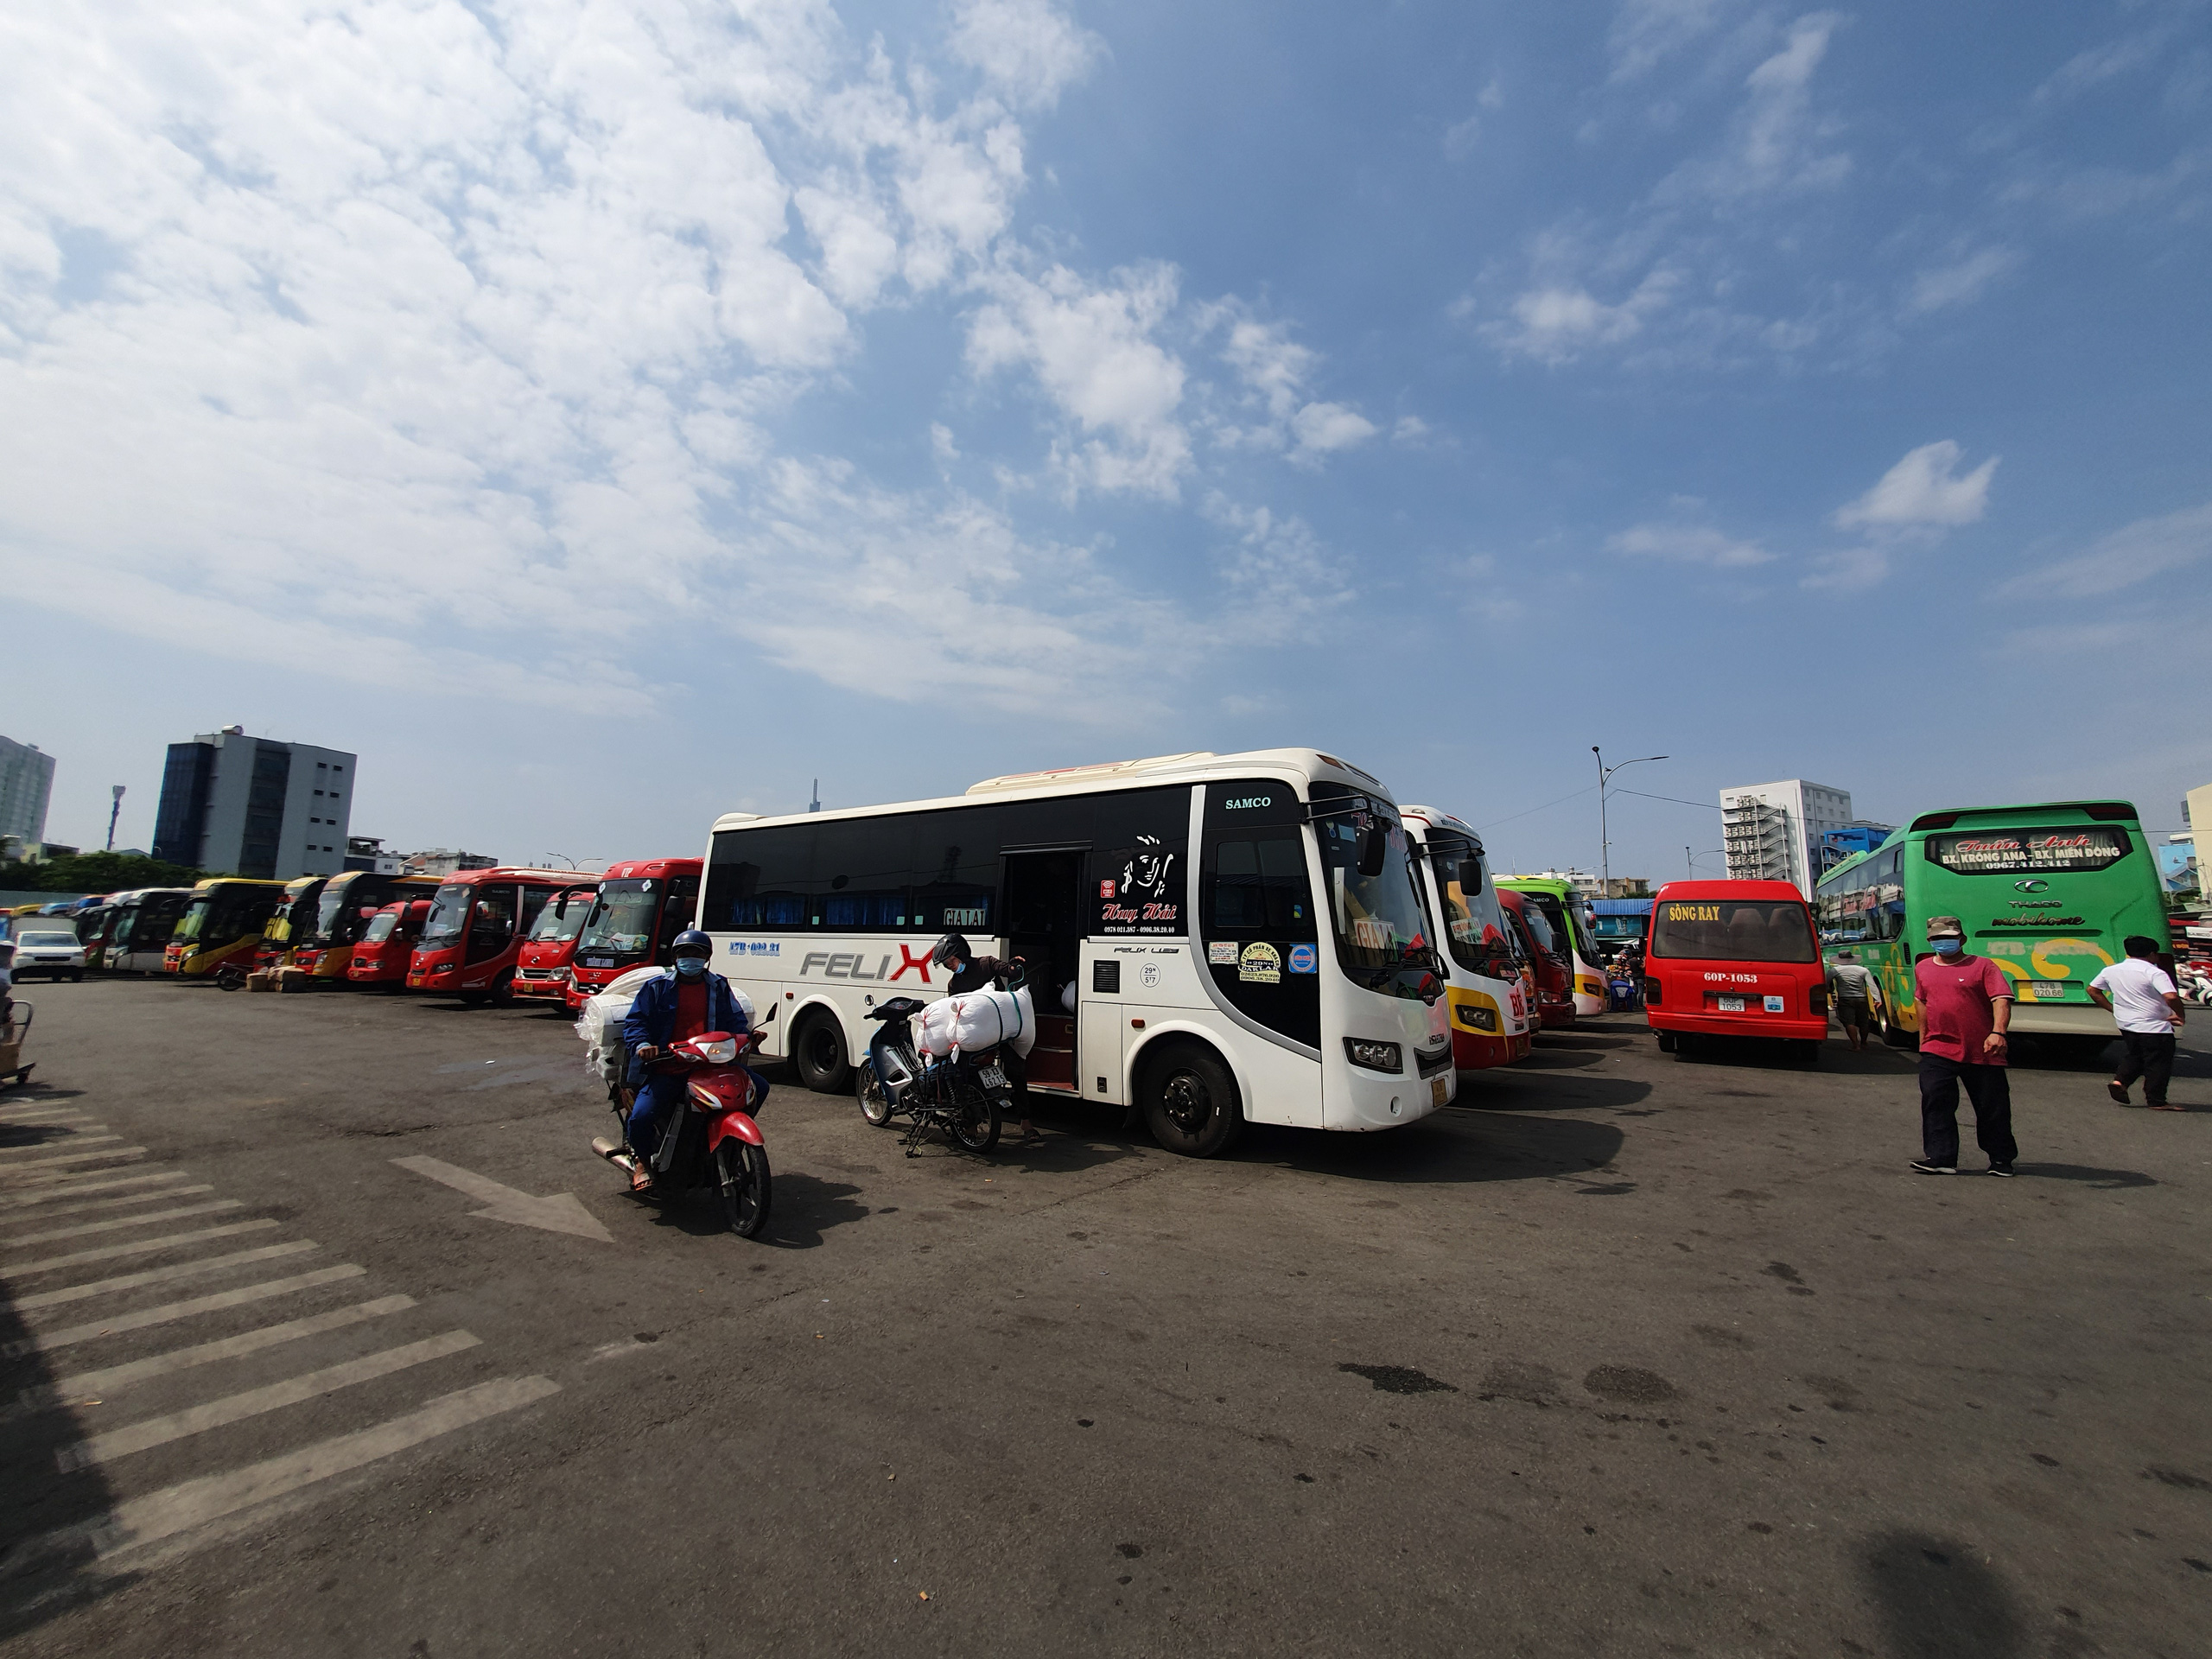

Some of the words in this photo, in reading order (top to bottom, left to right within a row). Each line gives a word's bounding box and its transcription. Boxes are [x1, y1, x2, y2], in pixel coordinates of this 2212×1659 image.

[1225, 797, 1271, 810] SAMCO
[2026, 835, 2092, 848] Anh
[1961, 852, 2000, 863] KRÔNG
[944, 909, 963, 926] GIA
[1102, 903, 1138, 923] Huy
[1142, 903, 1177, 920] Hải
[1669, 903, 1696, 921] SÔNG
[1698, 906, 1720, 921] RAY
[1357, 922, 1380, 949] GIA
[798, 944, 933, 984] FELIX
[1703, 972, 1758, 983] 60P-1053
[1722, 1002, 1742, 1011] 1053
